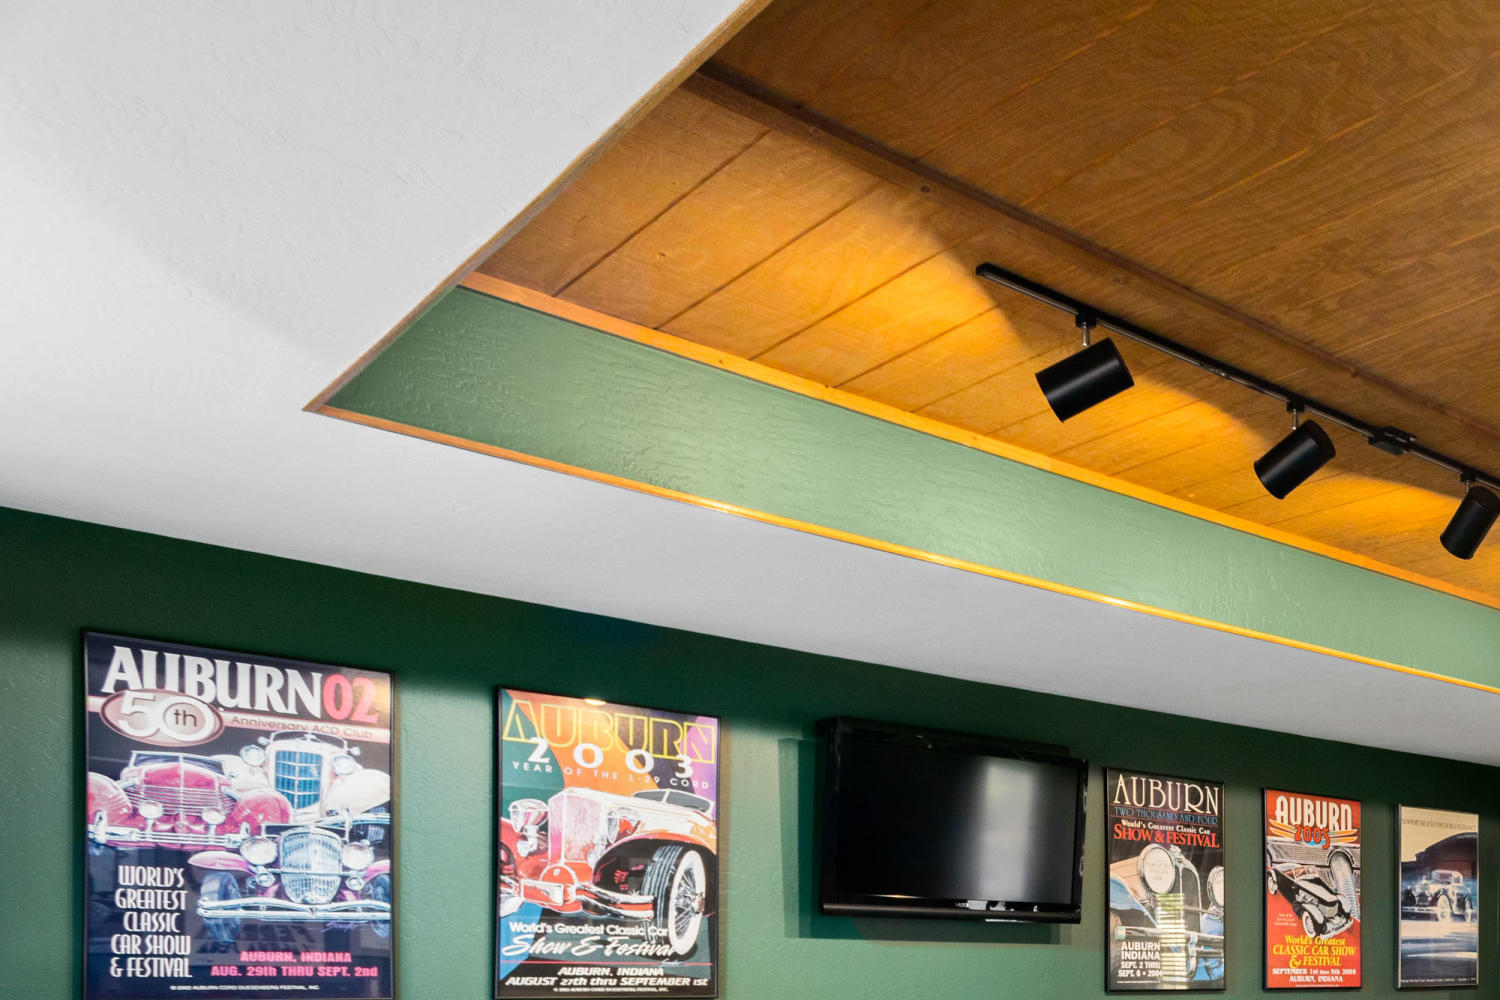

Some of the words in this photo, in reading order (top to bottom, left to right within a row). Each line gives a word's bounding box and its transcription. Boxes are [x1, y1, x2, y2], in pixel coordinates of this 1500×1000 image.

[101, 645, 322, 719] AUBURN
[323, 674, 378, 723] 02
[231, 716, 309, 731] Anniversary
[312, 725, 340, 736] ACD
[343, 727, 373, 738] Club
[502, 699, 715, 764] AUBURN
[528, 737, 694, 779] 2003
[512, 761, 552, 773] YEAR
[564, 767, 582, 777] OF
[594, 770, 618, 780] THE
[629, 774, 660, 784] L-29
[670, 778, 709, 789] CORD
[1113, 773, 1219, 816] AUBURN
[1114, 806, 1134, 817] TWO
[1136, 808, 1177, 821] THOUSAND
[1180, 813, 1195, 823] AND
[1197, 815, 1218, 825] FOUR
[1275, 795, 1352, 831] AUBURN
[1113, 823, 1154, 841] SHOW
[1154, 831, 1164, 843] &
[1166, 832, 1220, 848] FESTIVAL
[1295, 824, 1330, 850] 2005
[118, 865, 185, 888] WORLD'S
[115, 888, 188, 910] GREATEST
[123, 911, 181, 932] CLASSIC
[509, 921, 552, 933] World's
[554, 923, 604, 935] Greatest
[606, 924, 645, 936] Classic
[649, 925, 670, 936] Car
[110, 934, 142, 955] CAR
[145, 934, 191, 955] SHOW
[502, 935, 572, 956] Show
[572, 936, 604, 956] &
[1121, 941, 1160, 951] AUBURN
[1272, 944, 1310, 955] CLASSIC
[1311, 945, 1331, 955] CAR
[1331, 946, 1356, 956] SHOW
[1285, 935, 1313, 945] World's
[1314, 936, 1346, 945] Greatest
[240, 951, 297, 963] AUBURN,
[301, 951, 352, 963] INDIANA
[1121, 951, 1160, 960] INDIANA
[1121, 961, 1137, 969] SEPT.
[1139, 961, 1143, 969] 2
[1144, 961, 1160, 969] THRU
[1289, 955, 1301, 969] &
[1303, 956, 1341, 966] FESTIVAL
[110, 957, 124, 978] &
[127, 957, 193, 977] FESTIVAL
[210, 966, 242, 977] AUG.
[246, 966, 277, 977] 29th
[281, 966, 314, 977] THRU
[317, 966, 350, 977] SEPT.
[354, 966, 379, 977] 2nd
[616, 967, 664, 976] INDIANA
[1118, 969, 1135, 977] SEPT.
[505, 977, 558, 986] AUGUST
[560, 978, 587, 986] 27th
[589, 977, 618, 986] thru
[619, 977, 691, 986] SEPTEMBER
